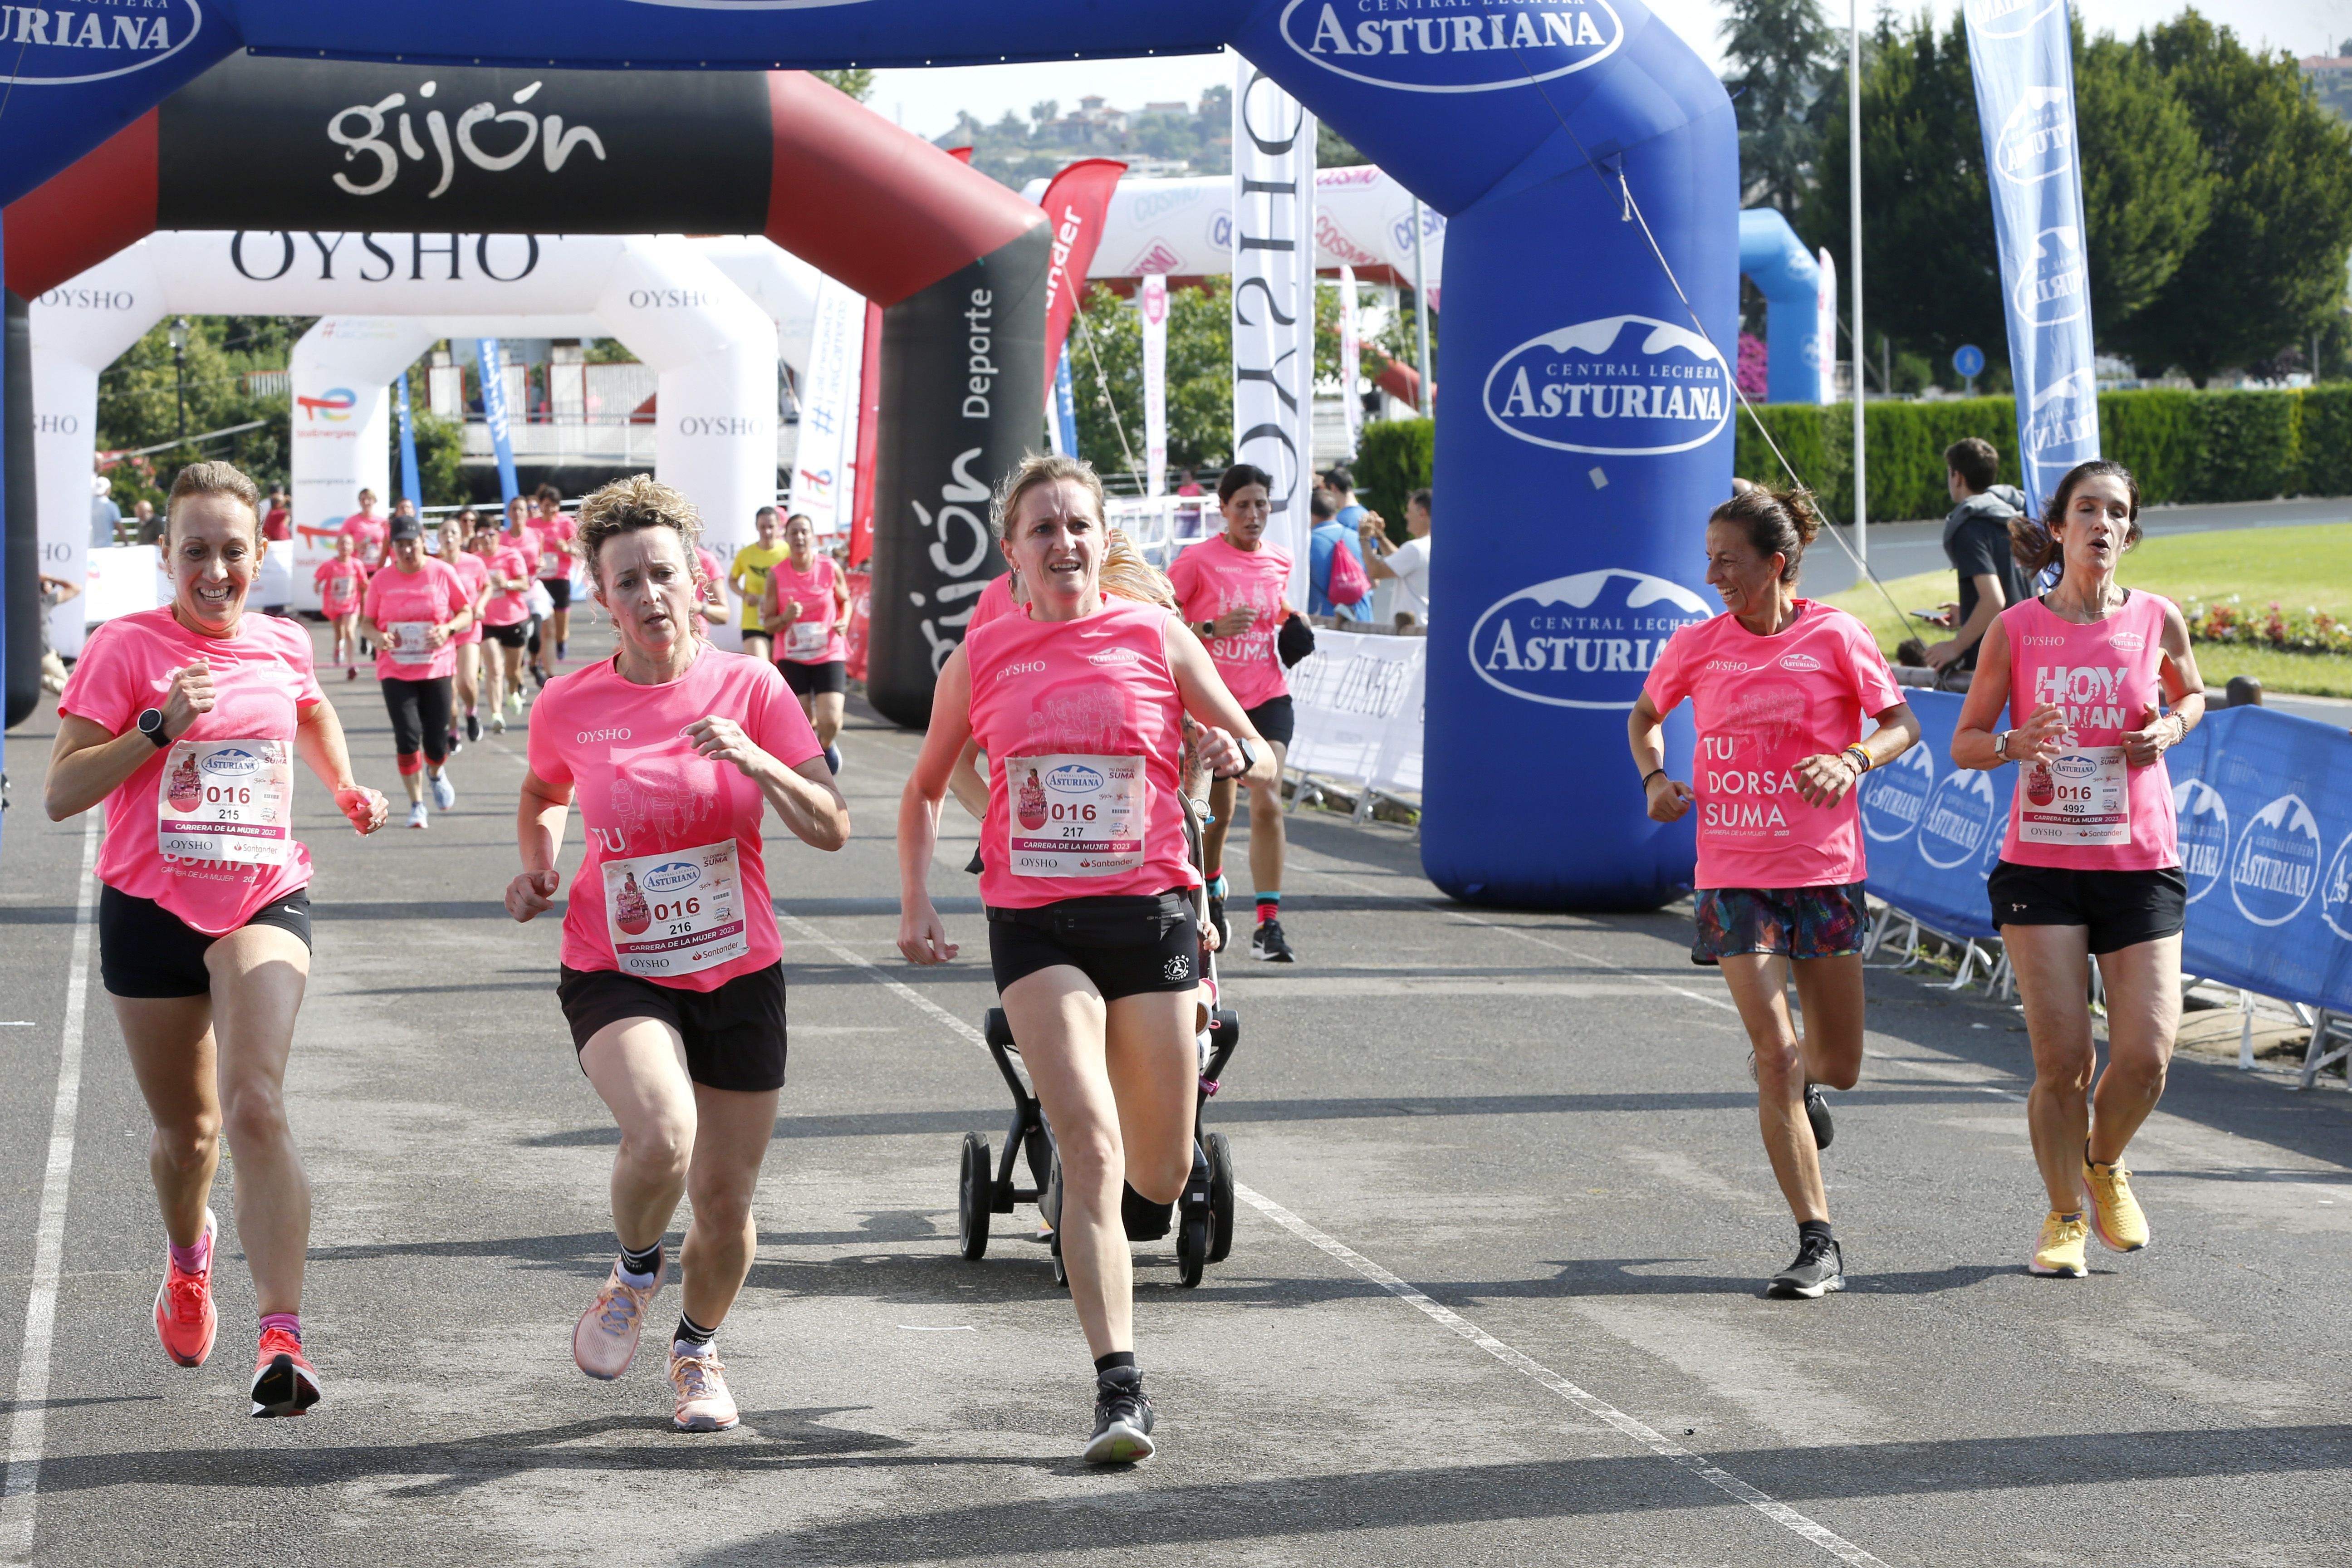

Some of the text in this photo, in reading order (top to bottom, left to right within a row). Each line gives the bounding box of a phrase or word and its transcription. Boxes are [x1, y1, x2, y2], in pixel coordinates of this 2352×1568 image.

[1310, 2, 1606, 56] ASTURIANA
[328, 80, 607, 199] gijón
[230, 232, 539, 281] OYSHO
[38, 289, 133, 311] OYSHO
[962, 288, 999, 418] Deporte
[1546, 363, 1719, 379] CENTRAL LECHERA
[1500, 366, 1722, 420] ASTURIANA
[1530, 616, 1624, 631] CENTRAL
[2023, 635, 2064, 646] OYSHO
[1212, 639, 1270, 660] SUMA
[1706, 660, 1747, 671] OYSHO
[1784, 659, 1818, 668] ASTURIANA
[2035, 666, 2128, 705] HOY
[2050, 706, 2127, 729] ANAN
[577, 728, 631, 744] OYSHO
[1704, 737, 1733, 760] TU
[205, 758, 255, 770] ASTURIANA
[2056, 763, 2093, 772] ASTURIANA
[1050, 774, 1099, 786] ASTURIANA
[1708, 769, 1801, 794] DORSA
[207, 787, 250, 804] 016
[2058, 786, 2091, 799] 016
[219, 809, 239, 820] 215
[1051, 804, 1096, 821] 016
[1705, 803, 1787, 827] SUMA
[2063, 804, 2085, 813] 4992
[237, 826, 260, 834] MUJER
[1063, 827, 1084, 837] 217
[2031, 828, 2062, 837] OYSHO
[171, 840, 278, 854] OYSHO Santander
[704, 857, 728, 867] SUMA
[1021, 858, 1133, 868] OYSHO Santander
[2235, 836, 2311, 897] ASTURIANA
[647, 871, 697, 887] ASTURIANA
[654, 897, 700, 920] 016
[670, 921, 691, 935] 216
[692, 931, 716, 943] MUJER
[719, 926, 735, 936] 2023
[630, 941, 739, 968] OYSHO Santander
